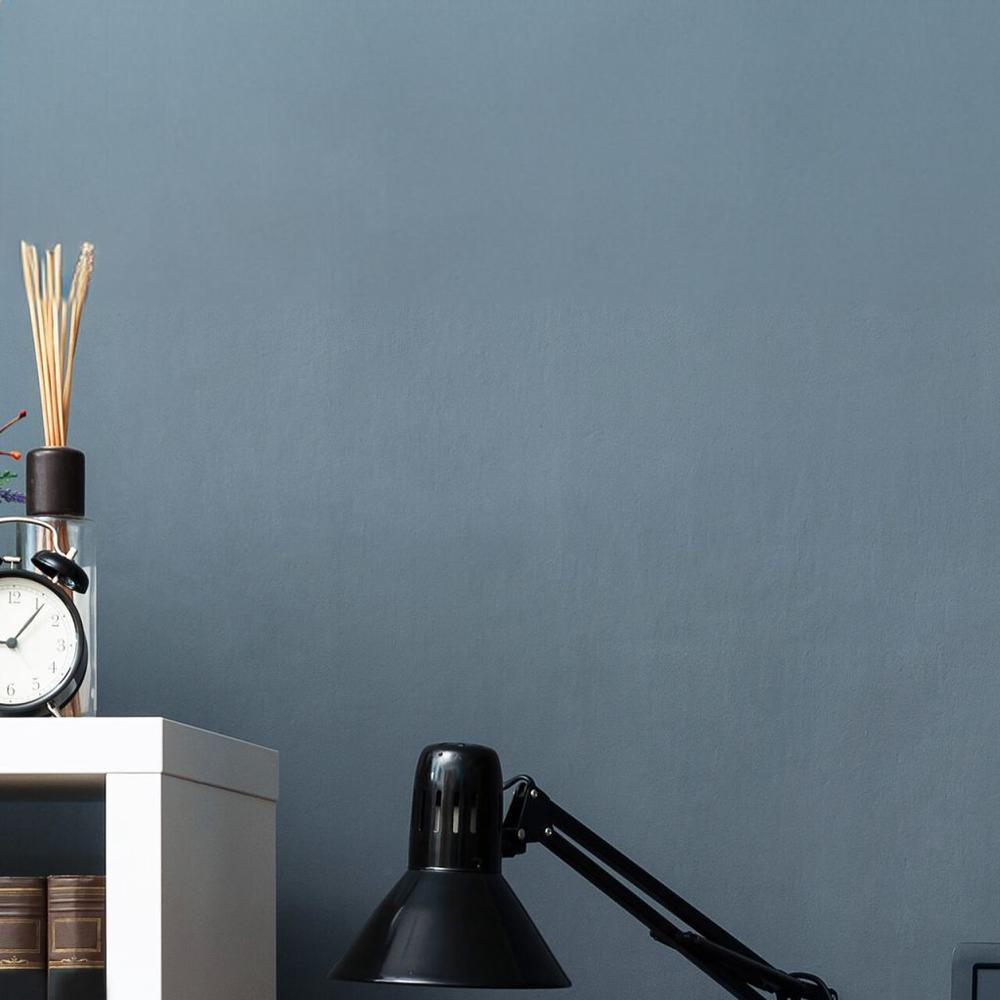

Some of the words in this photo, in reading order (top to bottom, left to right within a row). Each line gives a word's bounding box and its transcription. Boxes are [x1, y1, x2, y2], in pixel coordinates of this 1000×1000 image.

[8, 591, 21, 604] 12
[51, 614, 59, 627] 2
[57, 639, 66, 651] 3
[49, 661, 57, 673] 4
[7, 683, 15, 696] 6
[32, 678, 40, 690] 5
